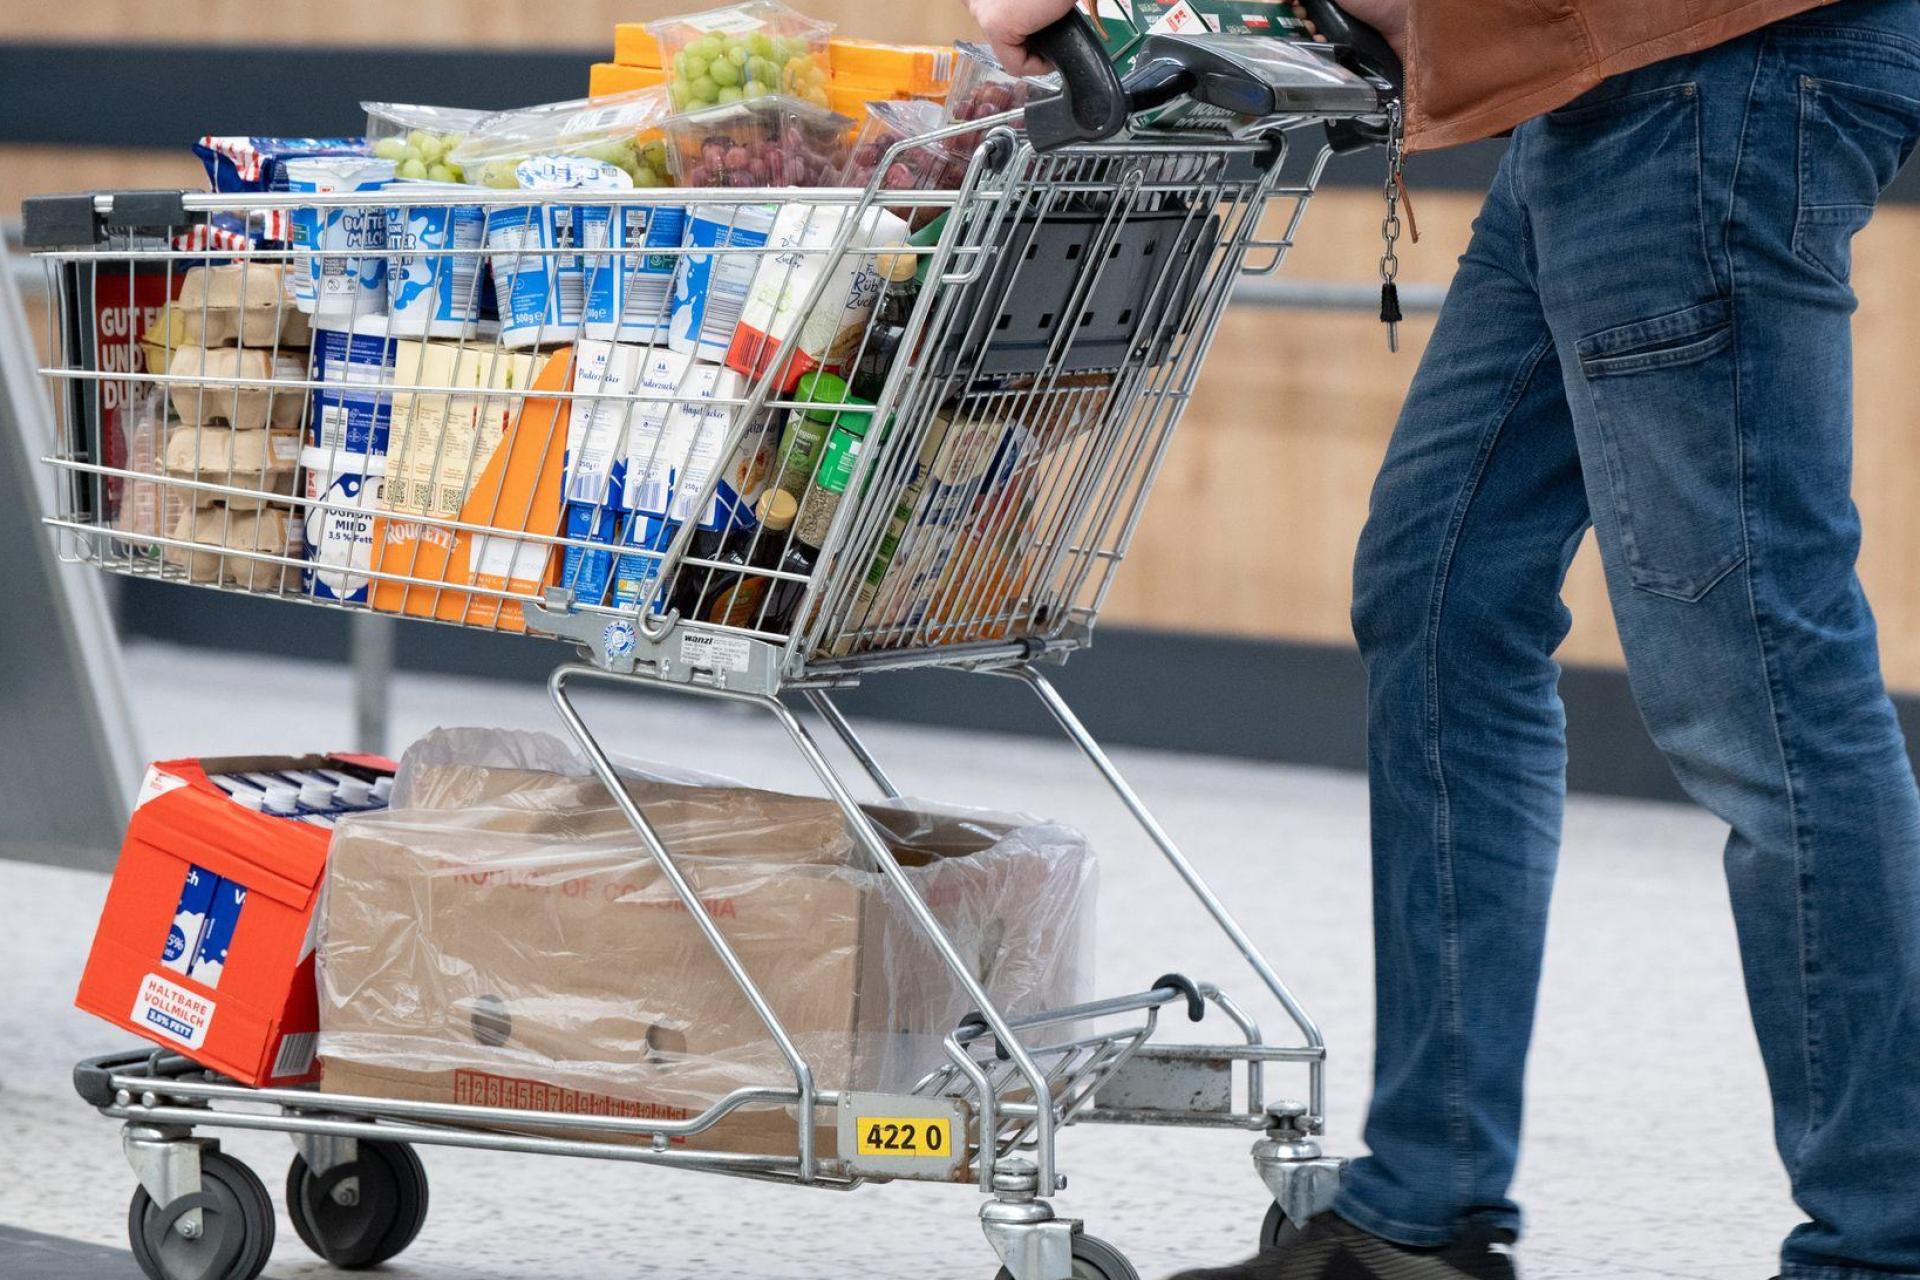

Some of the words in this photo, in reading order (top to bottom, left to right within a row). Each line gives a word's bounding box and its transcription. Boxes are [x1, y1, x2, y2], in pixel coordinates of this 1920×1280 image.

[101, 307, 140, 336] GUT
[102, 344, 143, 373] UND
[144, 992, 205, 1029] VOLLMILCH
[148, 980, 208, 1016] HALTBARE
[867, 1123, 916, 1150] 422
[926, 1124, 942, 1151] 0
